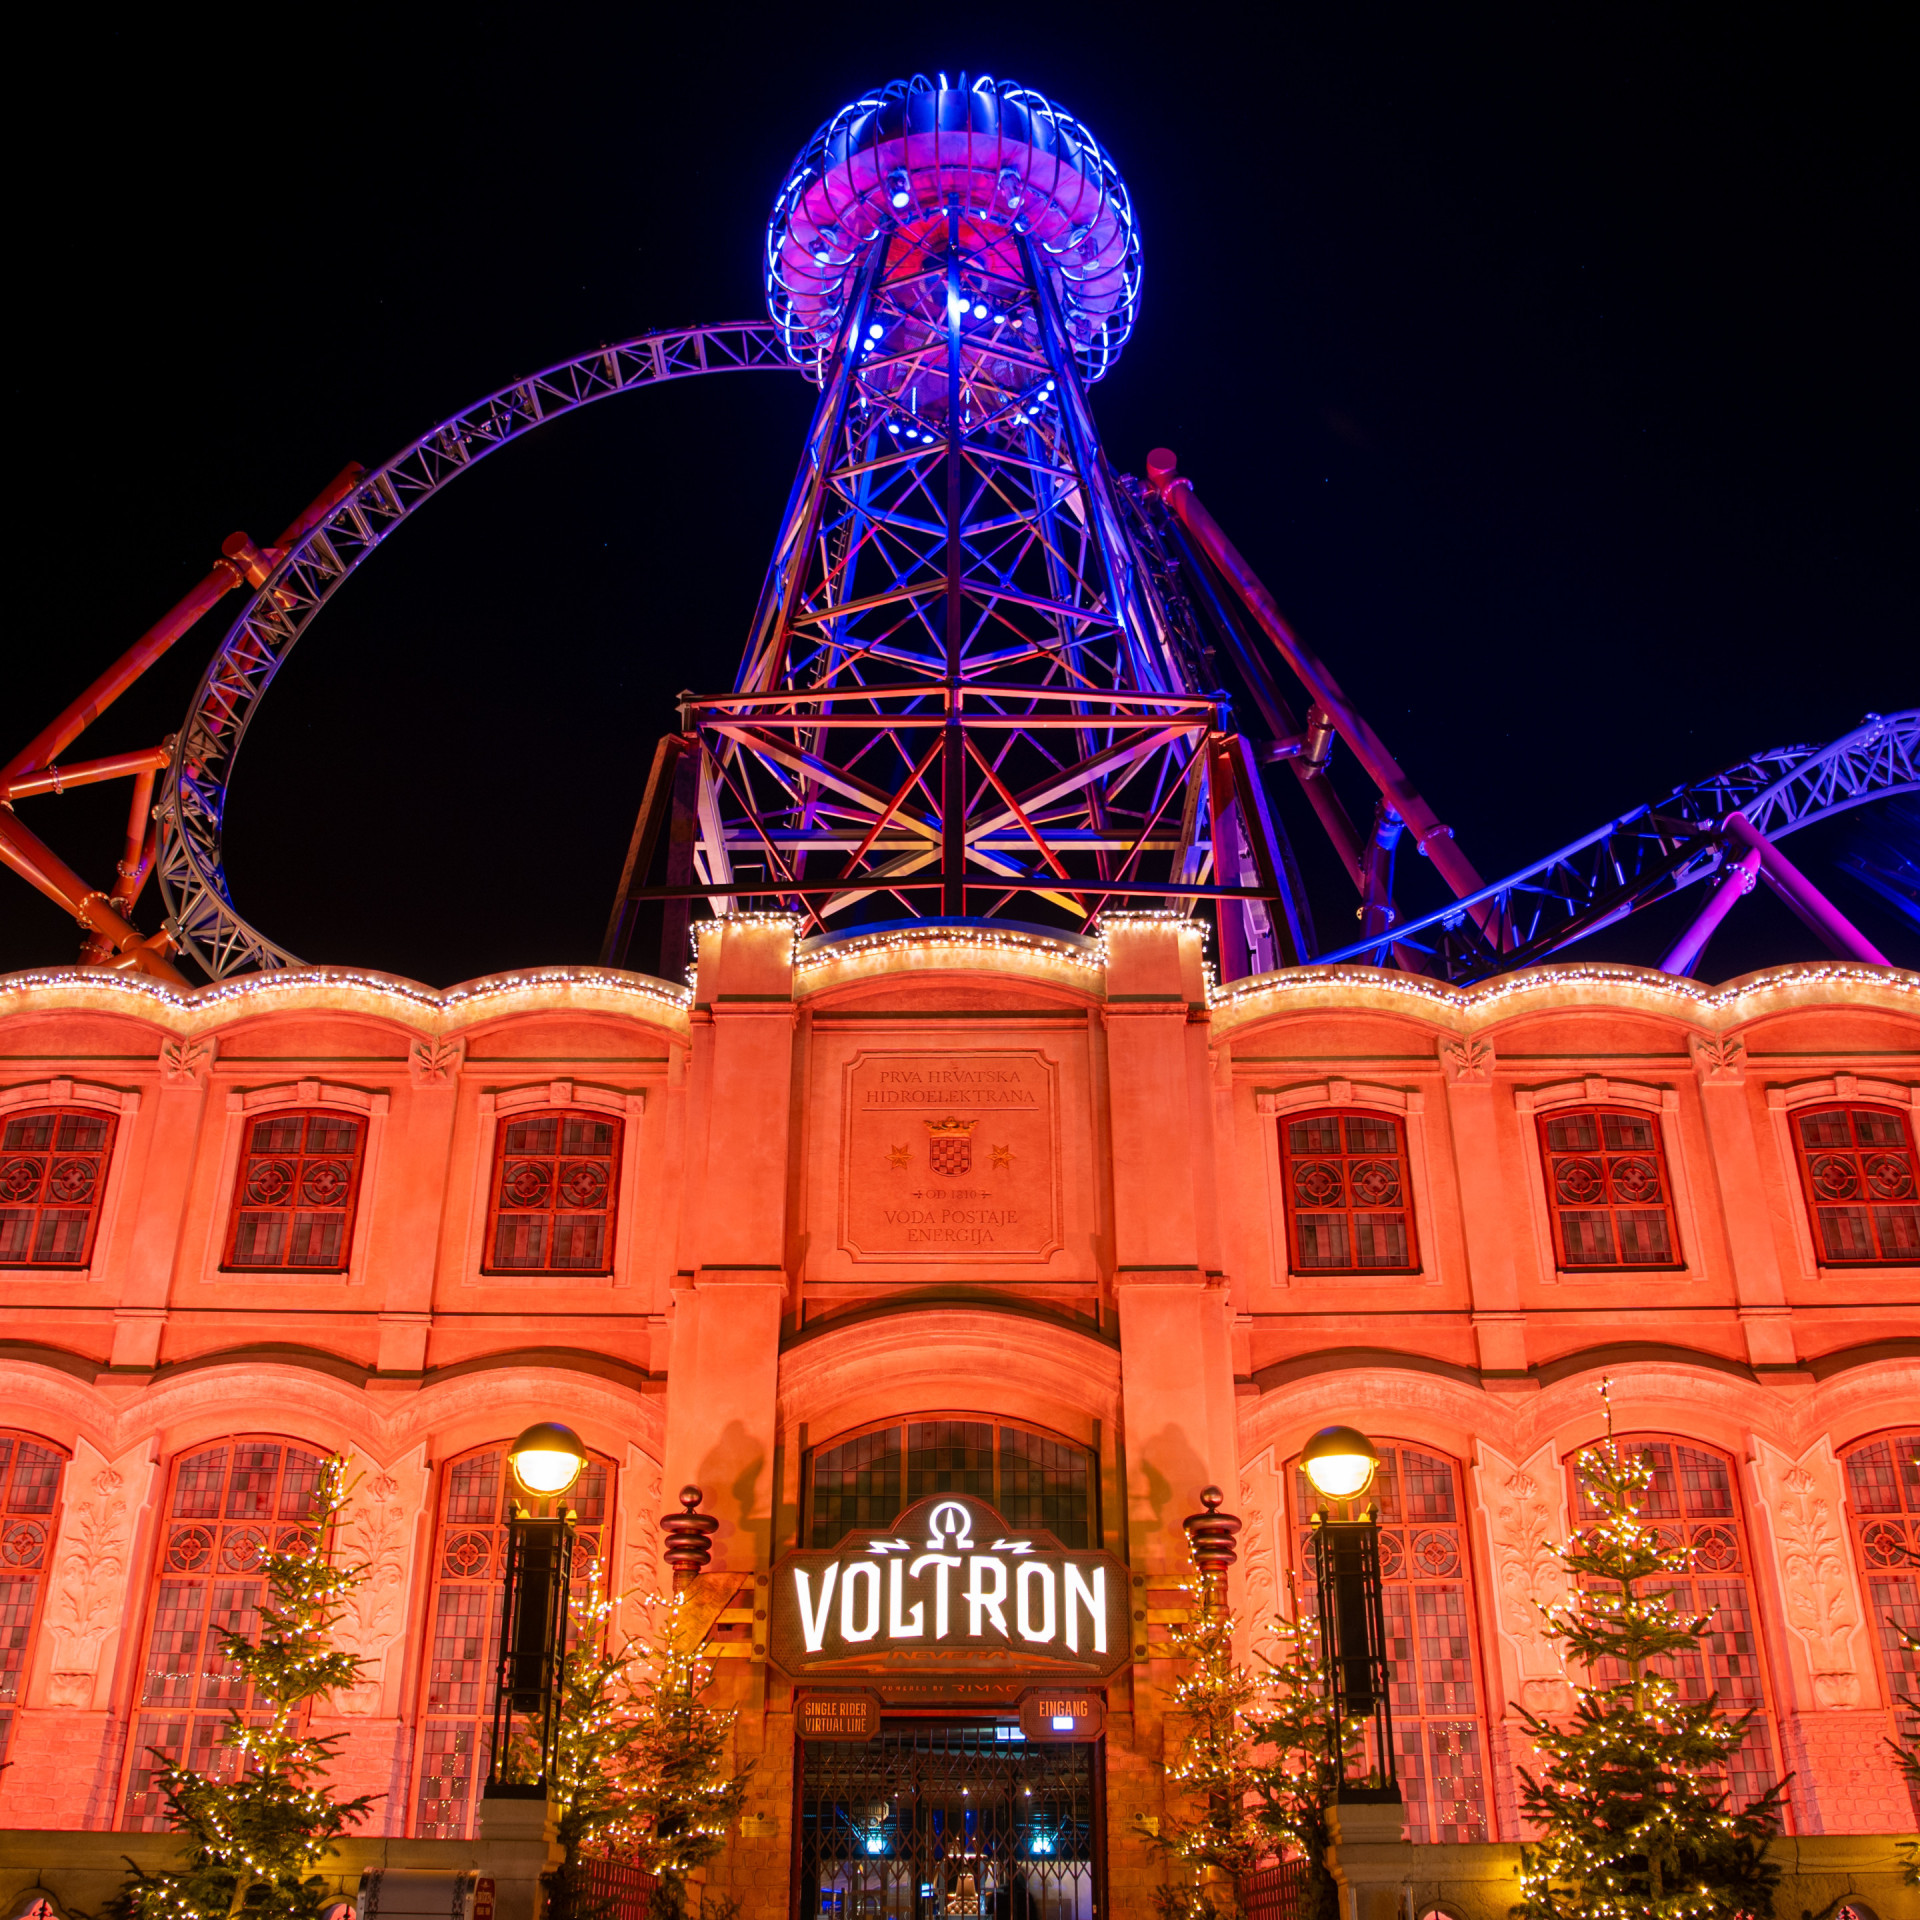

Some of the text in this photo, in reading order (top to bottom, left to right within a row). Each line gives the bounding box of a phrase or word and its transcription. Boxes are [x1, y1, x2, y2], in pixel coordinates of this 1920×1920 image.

[880, 1070, 1021, 1083] PRVA HRVATSKA
[866, 1090, 1035, 1103] HIDROELEKTRANA
[926, 1189, 946, 1200] OD
[884, 1209, 1018, 1227] VODA POSTAJE
[907, 1228, 994, 1245] ENERGIJA
[794, 1554, 1108, 1656] VOLTRON
[951, 1684, 1018, 1693] RIMAC
[805, 1702, 867, 1716] SINGLE RIDER
[1039, 1700, 1088, 1717] EINGANG
[805, 1718, 867, 1732] VIRTUAL LINE
